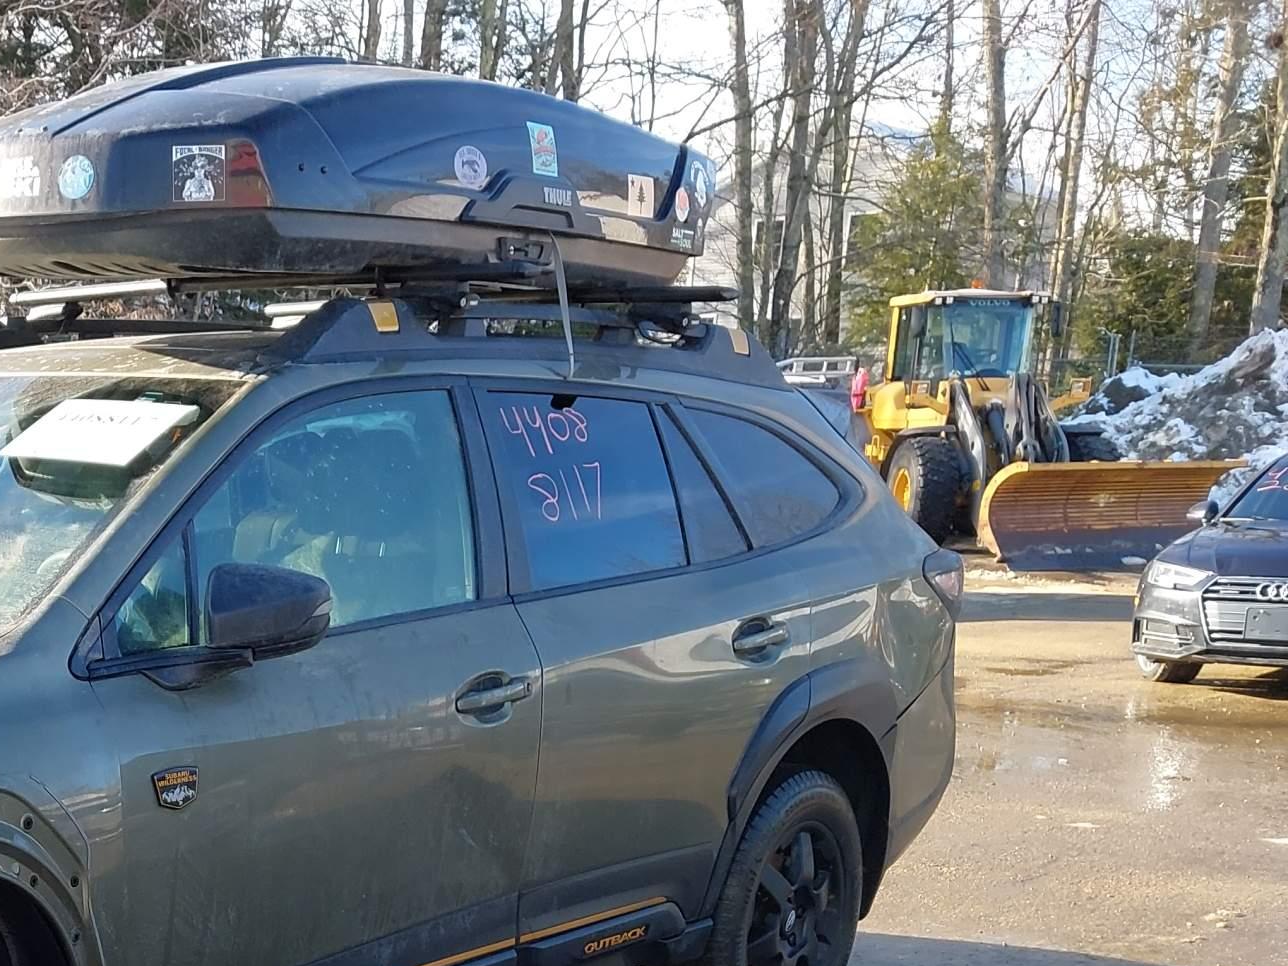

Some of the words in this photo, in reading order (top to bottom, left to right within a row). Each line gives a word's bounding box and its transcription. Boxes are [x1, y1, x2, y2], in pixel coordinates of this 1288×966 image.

[543, 187, 572, 207] THULE
[499, 405, 588, 457] 4408
[527, 461, 601, 521] 8117
[165, 771, 190, 780] SUBARU
[584, 925, 647, 954] OUTBACK
